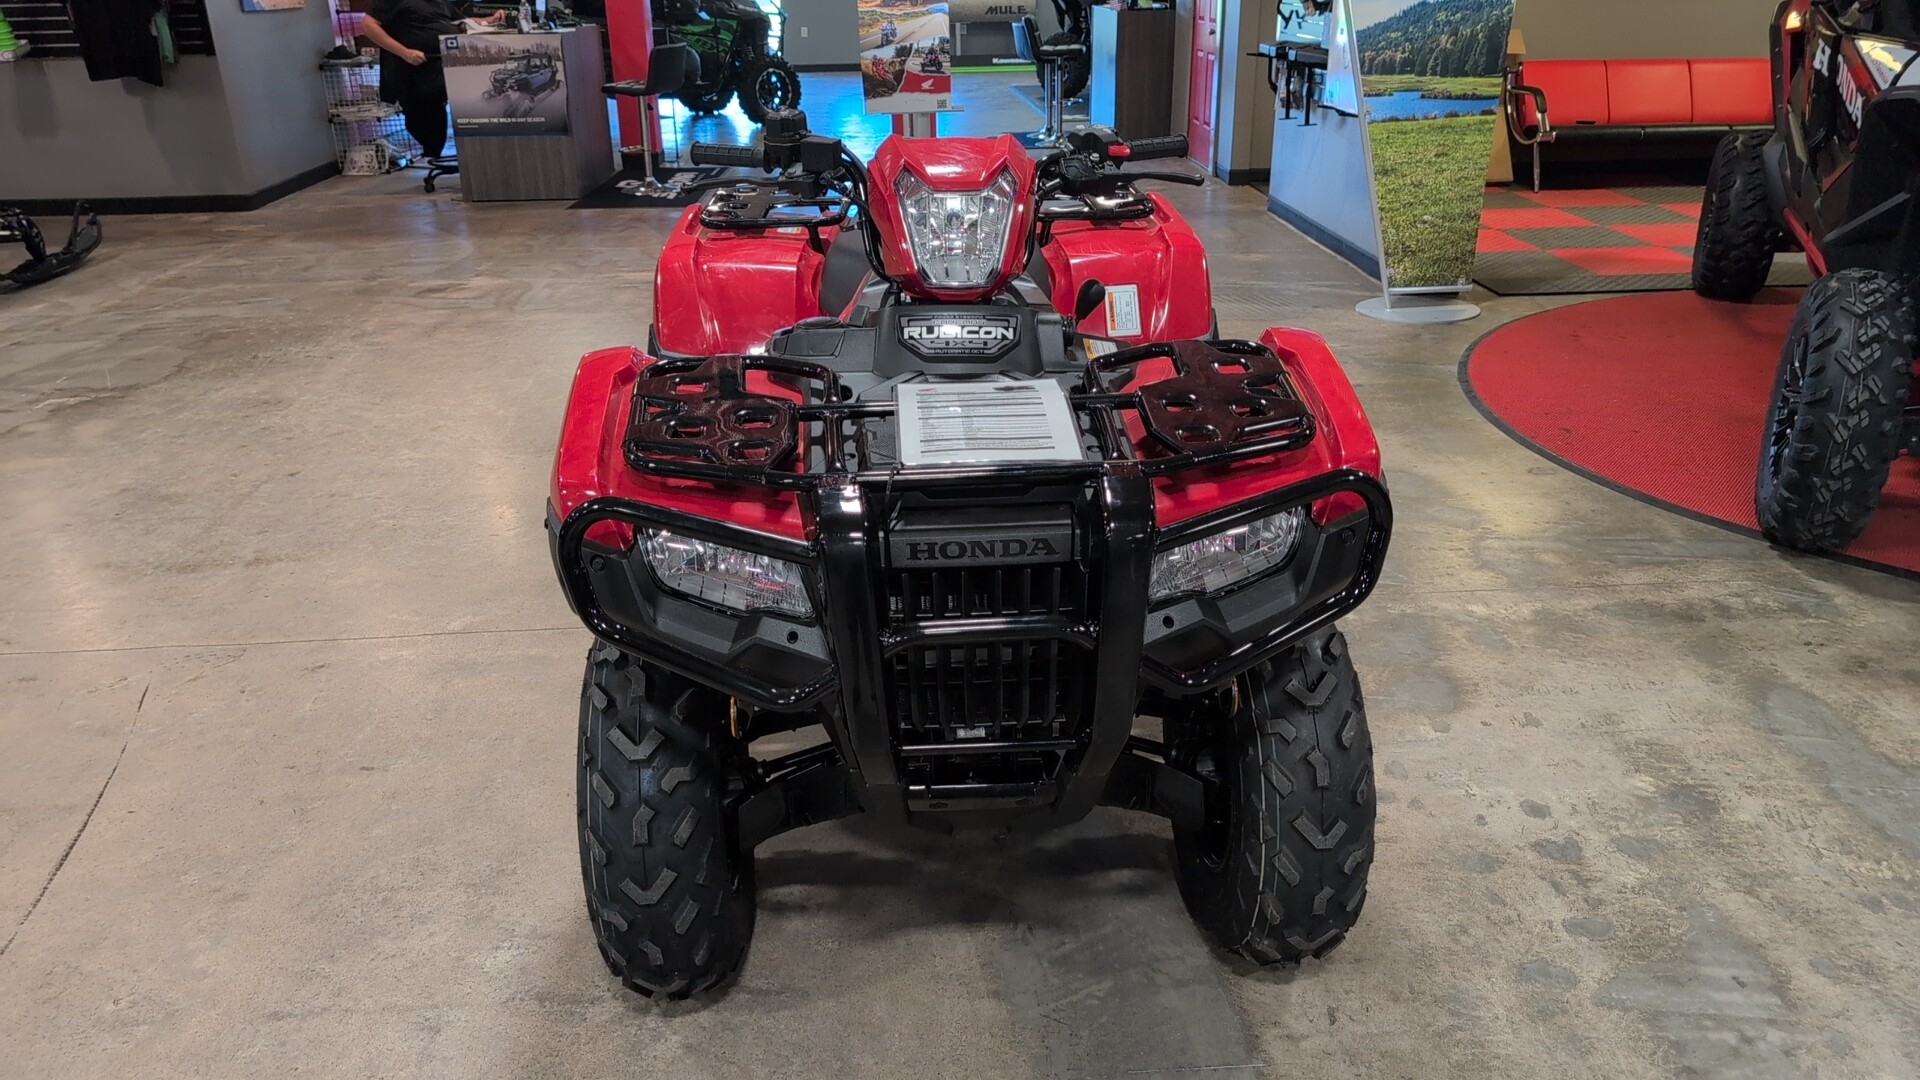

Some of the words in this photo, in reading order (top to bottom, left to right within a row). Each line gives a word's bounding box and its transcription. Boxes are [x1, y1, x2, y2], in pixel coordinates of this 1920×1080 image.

[984, 5, 1028, 15] MULE
[903, 326, 1014, 340] RUBICON
[906, 537, 1060, 561] HONDA
